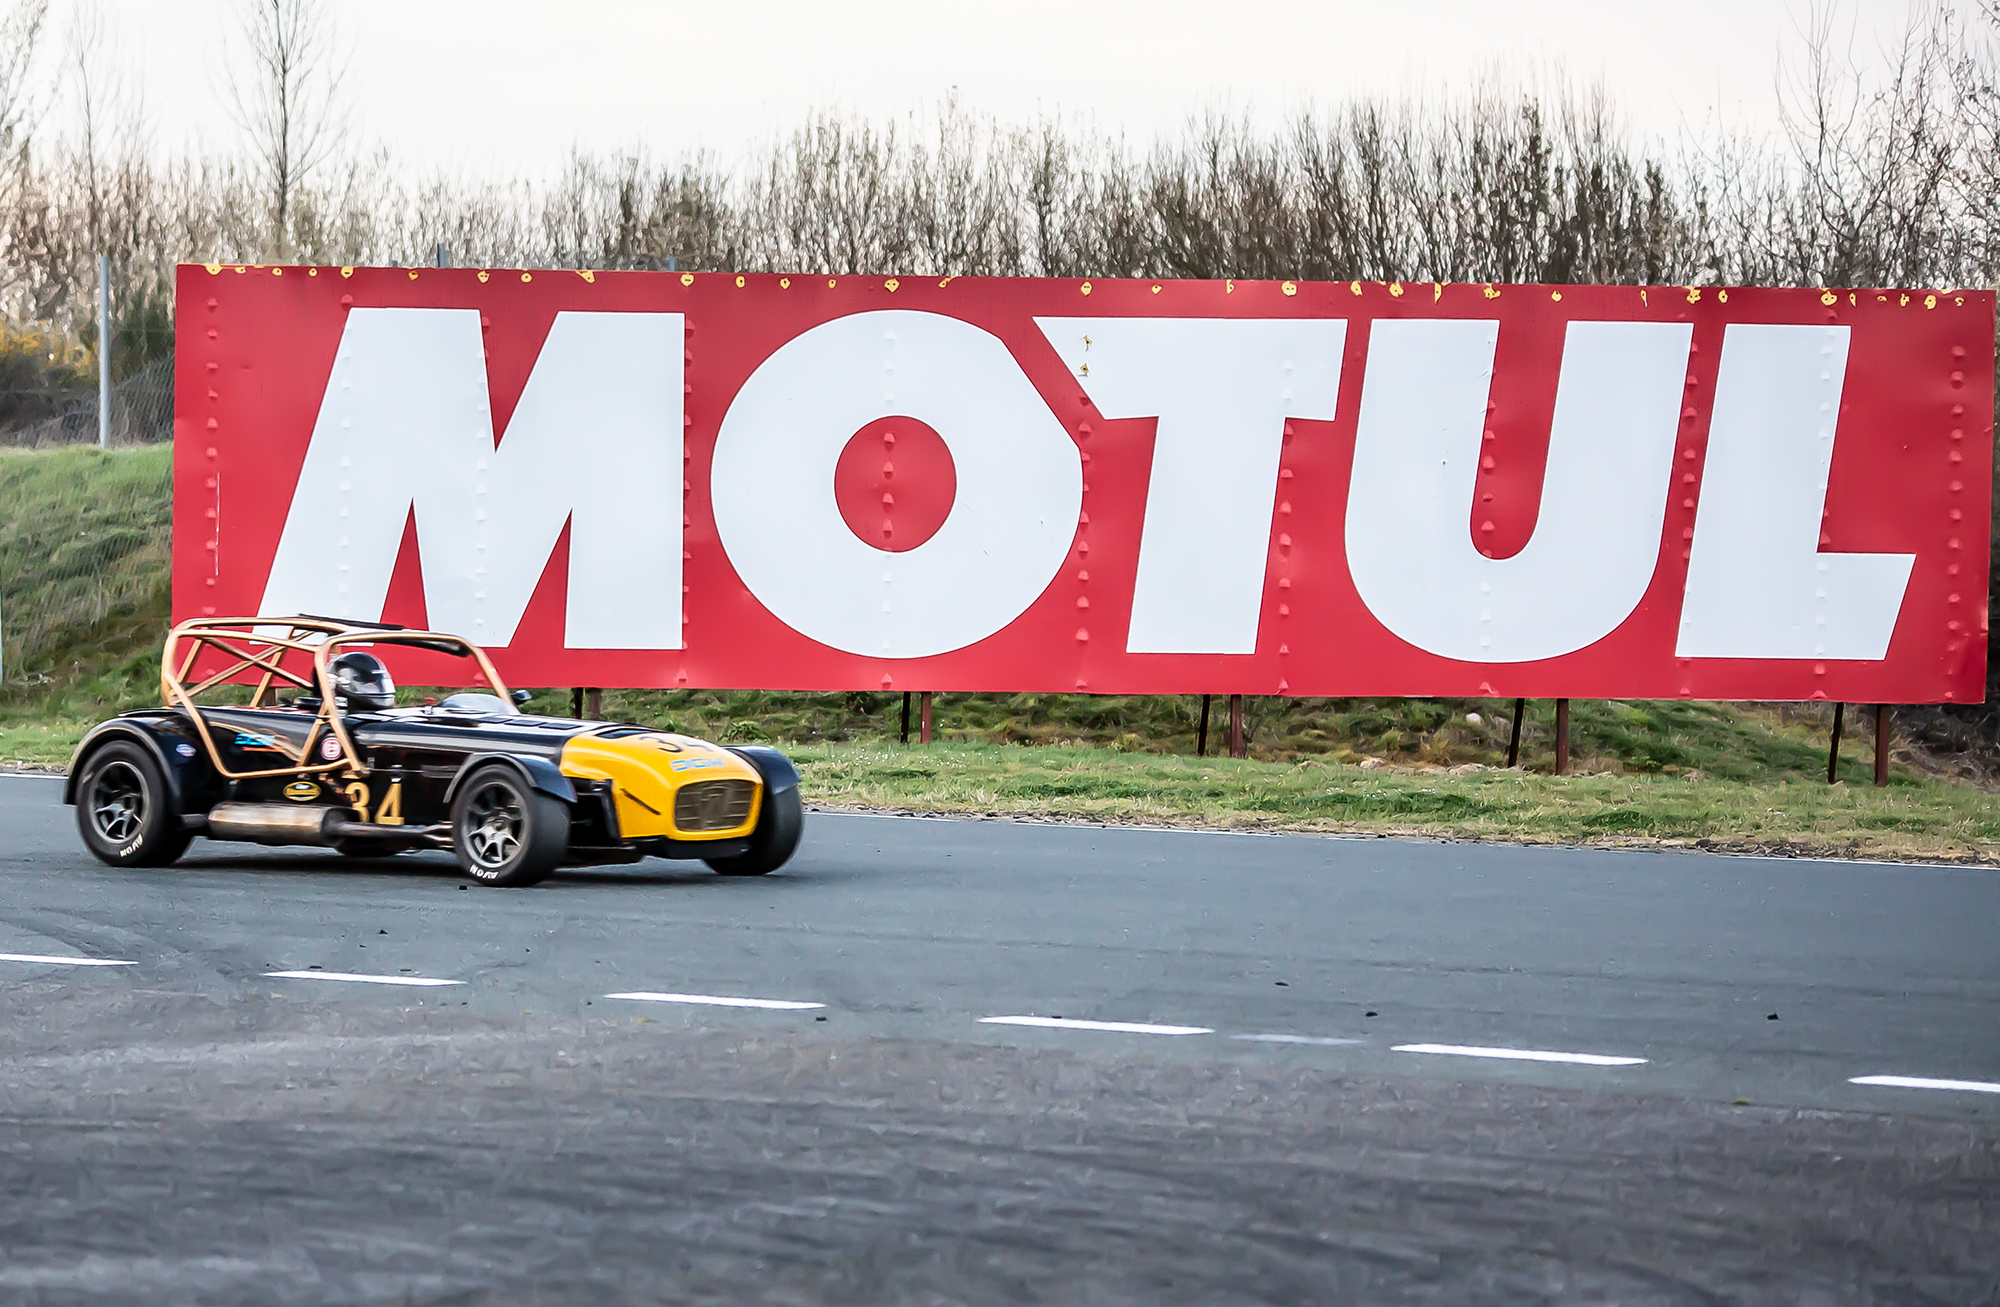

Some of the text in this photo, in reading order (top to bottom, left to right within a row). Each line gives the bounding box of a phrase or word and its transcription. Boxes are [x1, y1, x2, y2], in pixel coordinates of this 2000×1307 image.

[248, 308, 1917, 663] MOTUL
[344, 781, 405, 826] 34
[119, 832, 143, 857] AVON
[469, 862, 499, 880] AVON
